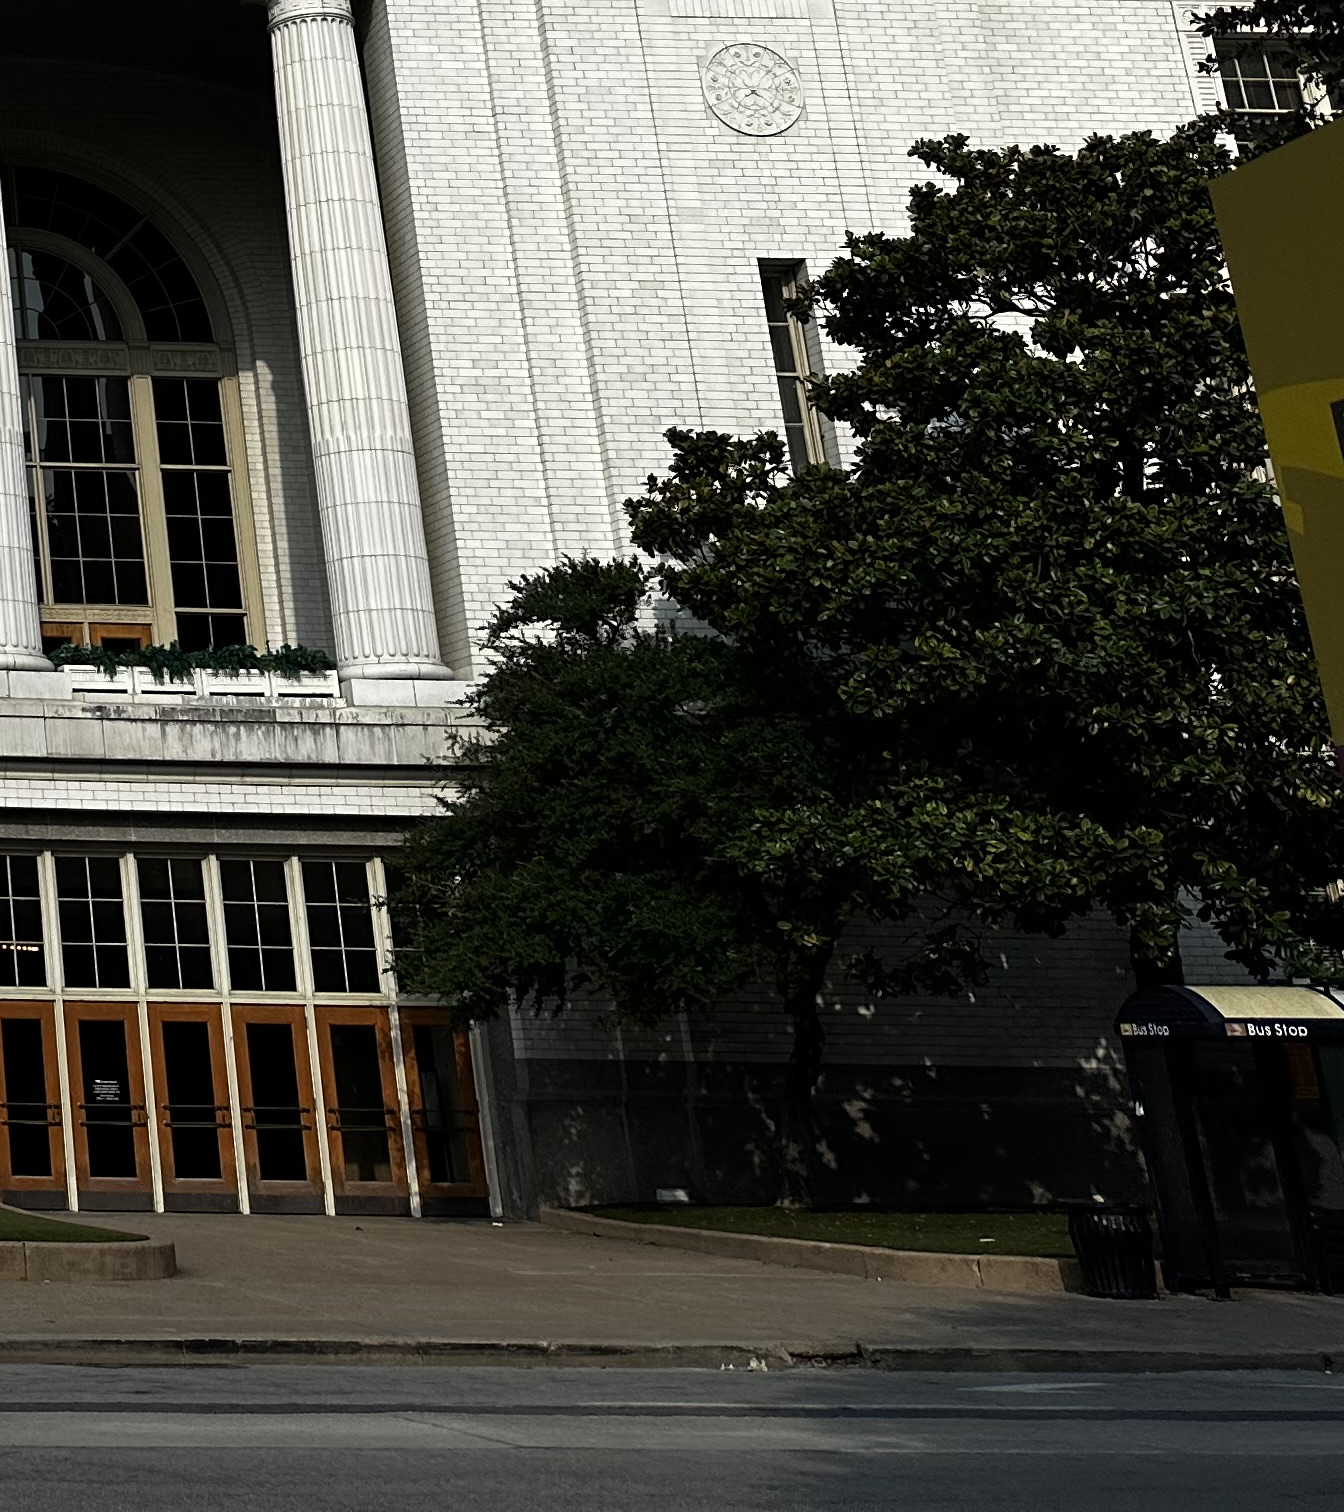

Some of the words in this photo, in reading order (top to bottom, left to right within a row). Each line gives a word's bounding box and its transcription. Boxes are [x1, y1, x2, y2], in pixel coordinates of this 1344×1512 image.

[1132, 1023, 1148, 1036] Bus
[1148, 1023, 1170, 1037] Stop
[1247, 1023, 1272, 1037] Bus
[1275, 1023, 1308, 1037] Stop
